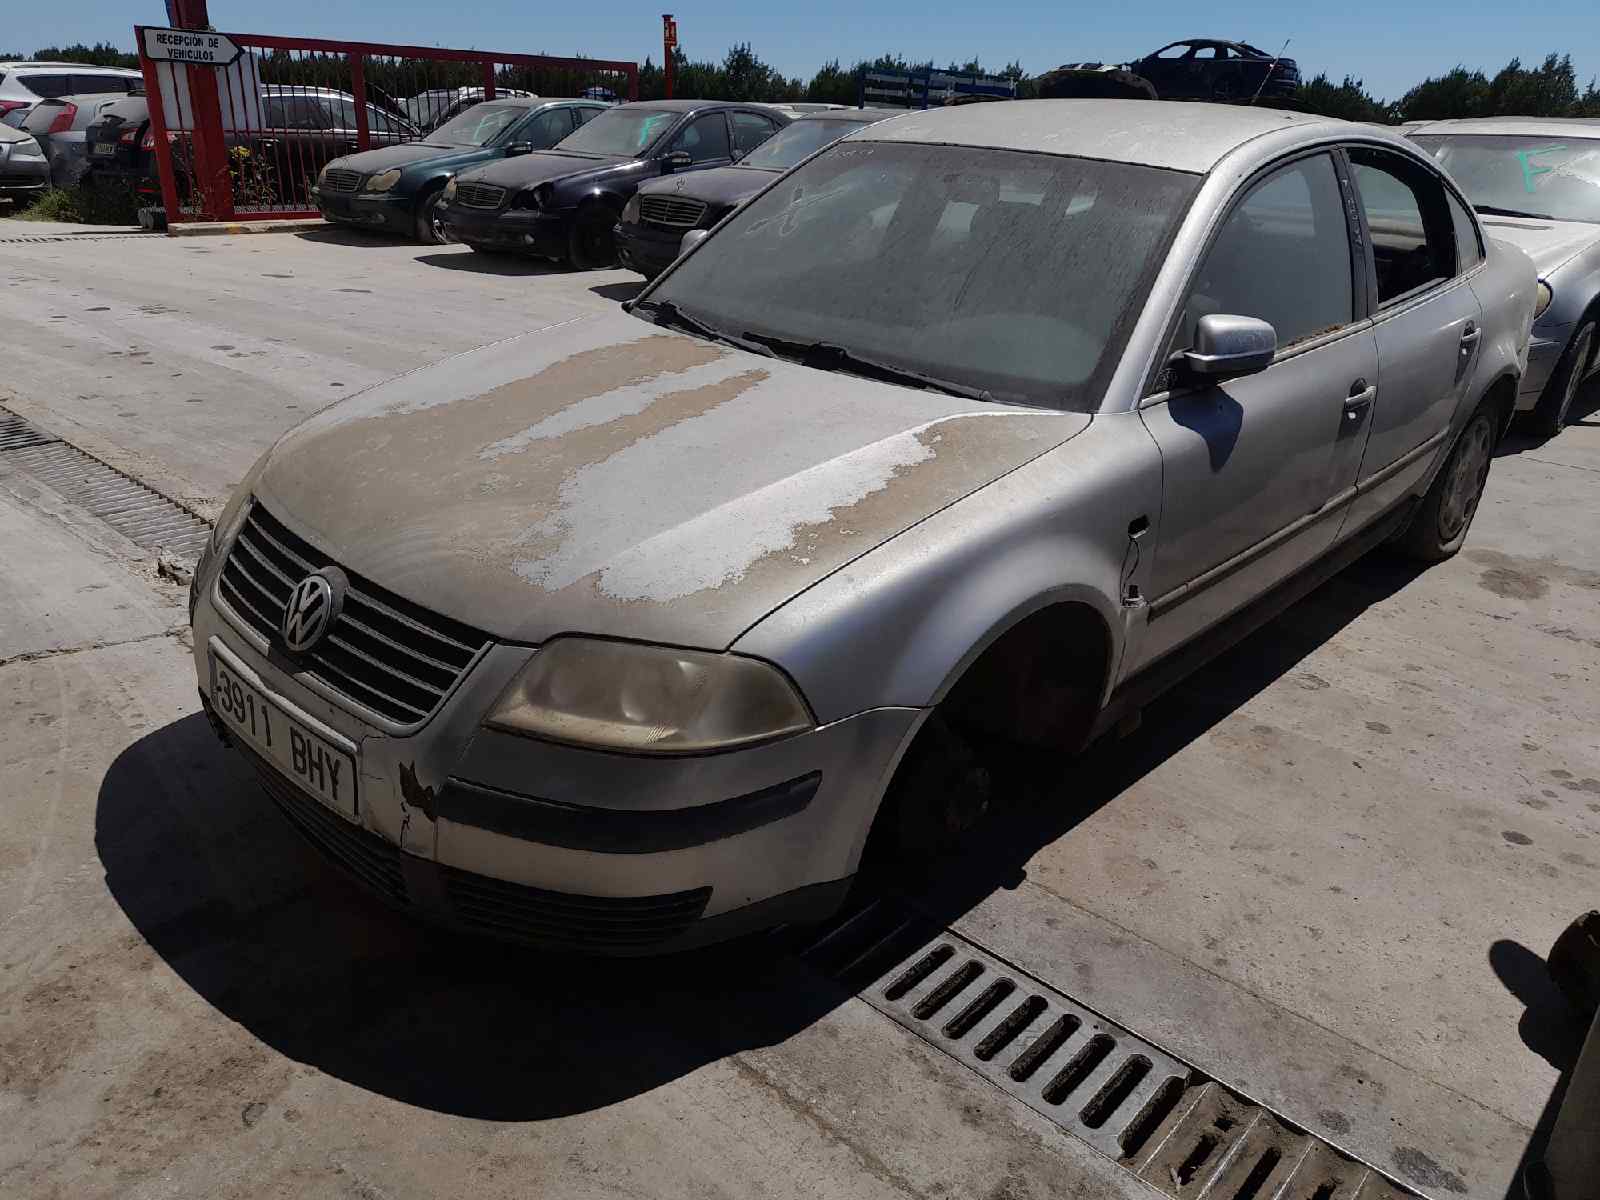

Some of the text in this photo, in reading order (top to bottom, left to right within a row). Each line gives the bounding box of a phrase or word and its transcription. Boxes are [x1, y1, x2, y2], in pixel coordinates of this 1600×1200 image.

[208, 38, 219, 48] DE
[1515, 144, 1568, 193] F
[219, 670, 341, 801] 3911 BHY
